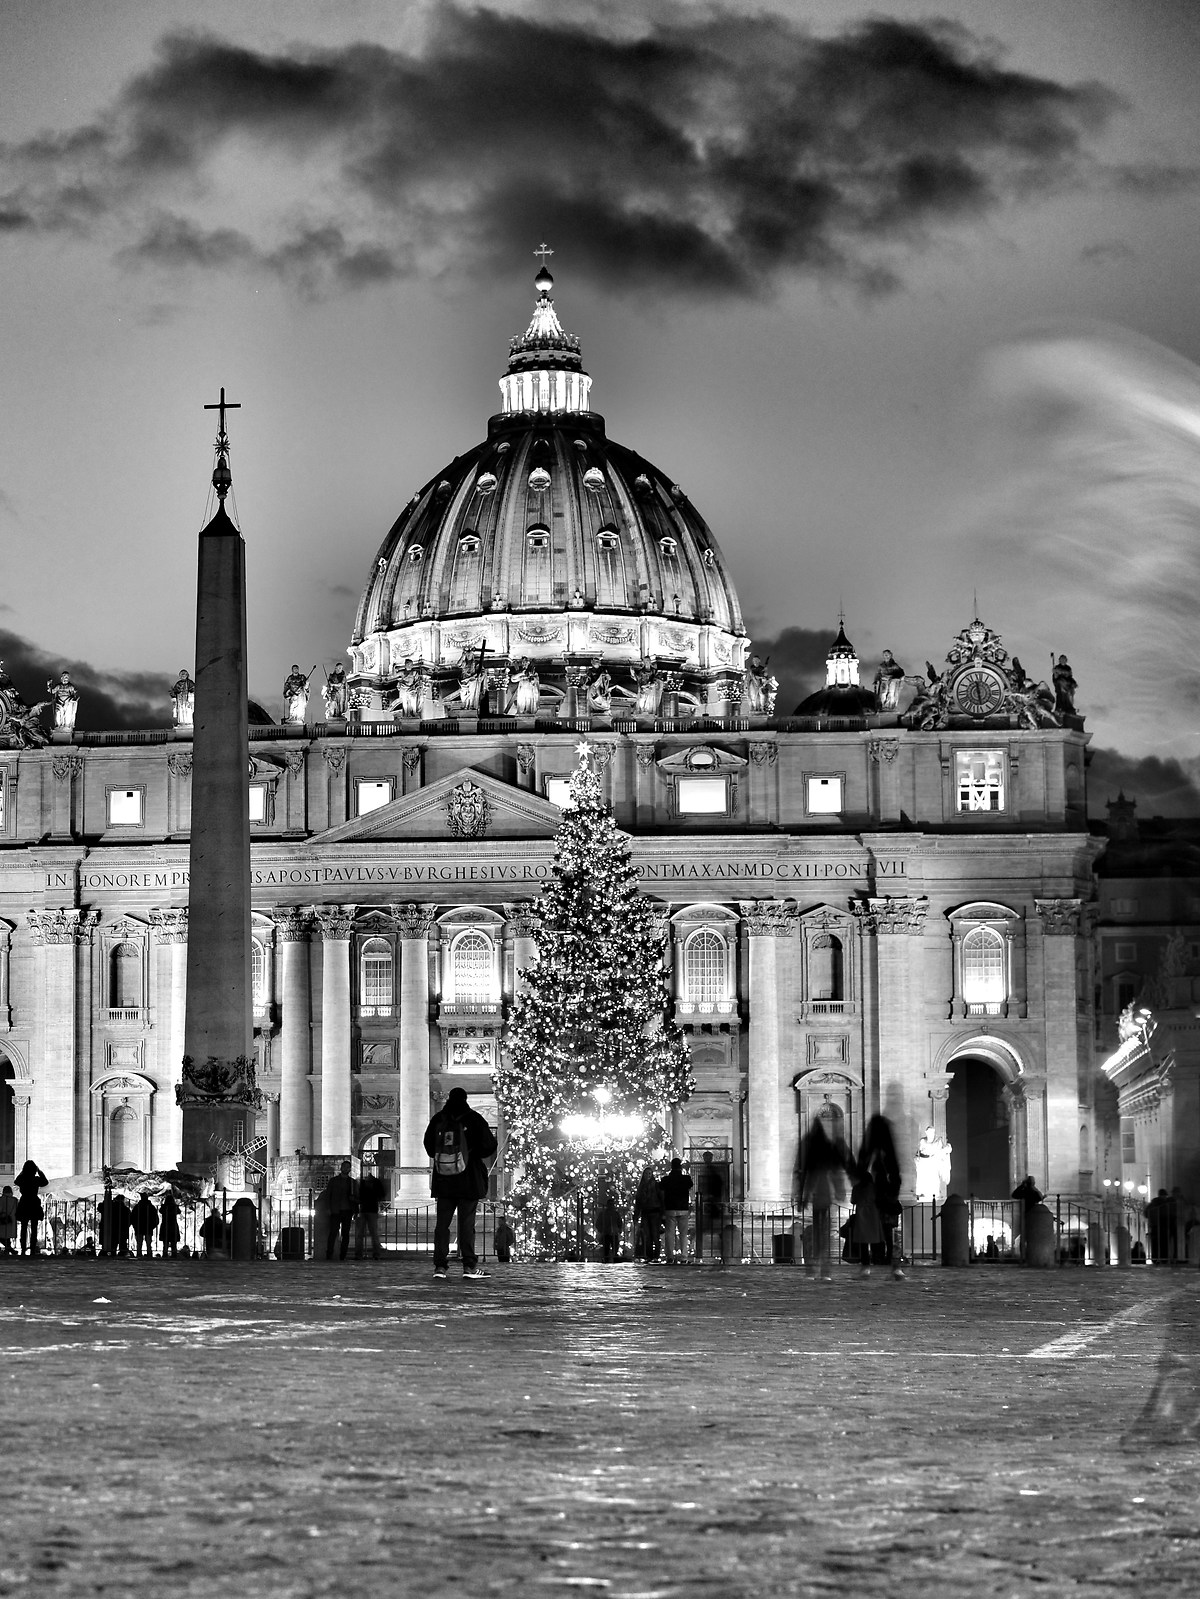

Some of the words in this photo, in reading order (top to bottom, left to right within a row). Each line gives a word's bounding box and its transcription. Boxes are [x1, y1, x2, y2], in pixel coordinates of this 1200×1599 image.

[46, 873, 67, 886] IN
[266, 869, 323, 884] APOST
[323, 866, 385, 881] PAVLVS
[403, 865, 517, 880] BVRGHESIVS
[671, 863, 711, 878] MAX
